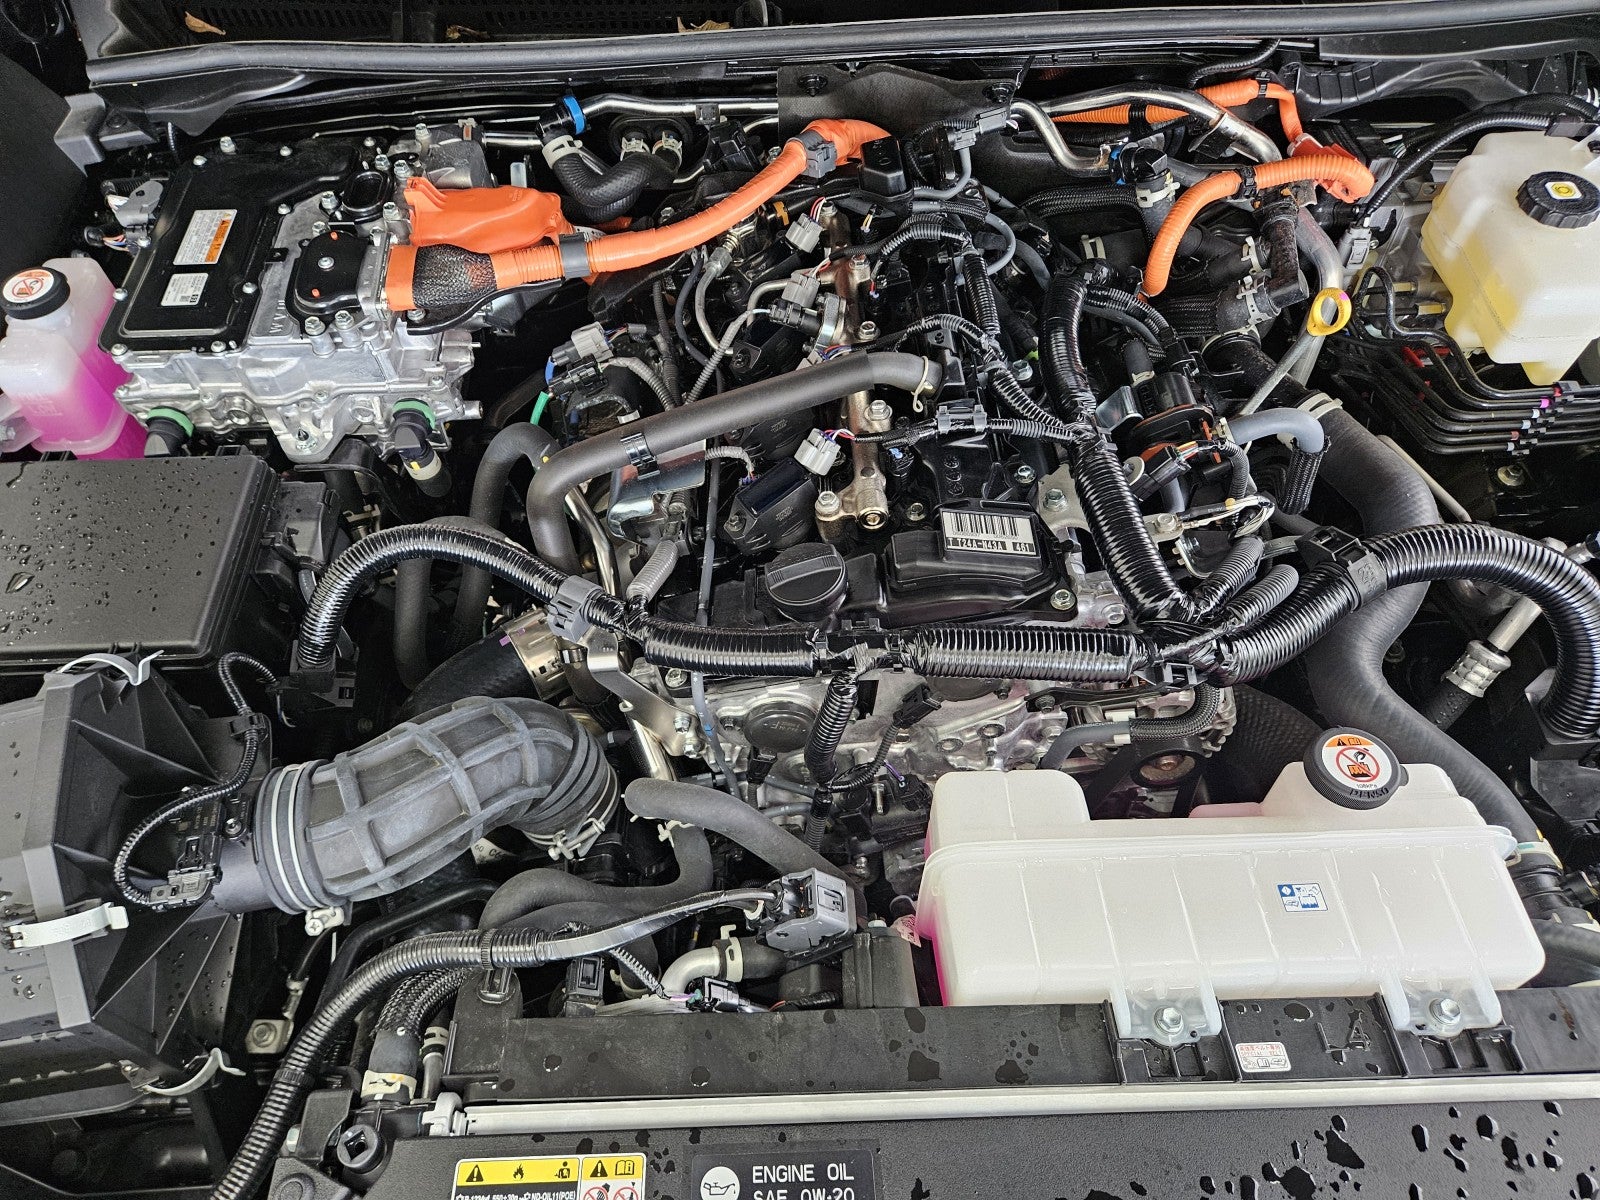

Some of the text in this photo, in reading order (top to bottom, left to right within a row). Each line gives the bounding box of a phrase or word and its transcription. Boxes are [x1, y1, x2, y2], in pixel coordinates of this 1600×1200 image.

[752, 1163, 854, 1183] ENGINE OIL
[753, 1189, 788, 1200] SAE
